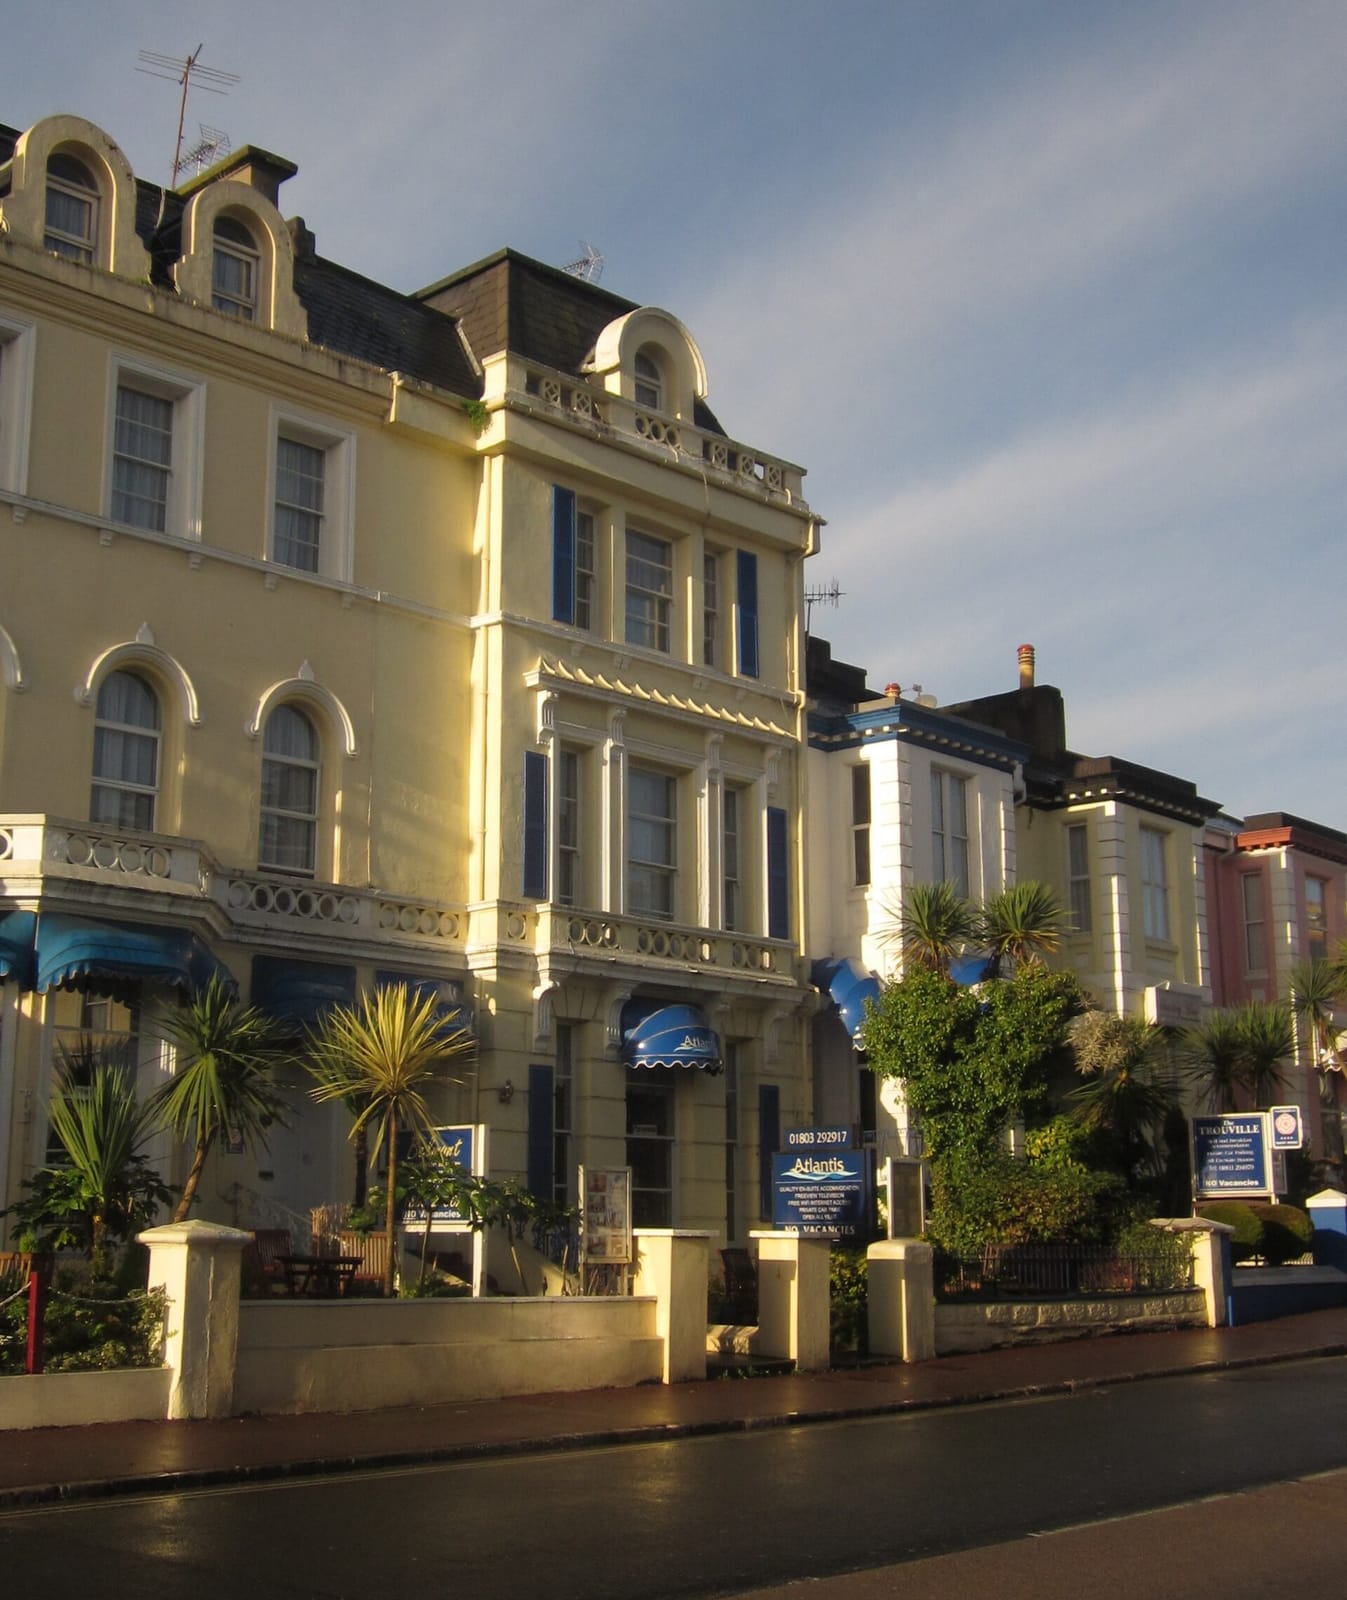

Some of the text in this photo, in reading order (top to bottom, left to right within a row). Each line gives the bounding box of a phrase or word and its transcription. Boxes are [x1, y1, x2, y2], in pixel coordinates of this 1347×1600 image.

[1200, 1124, 1260, 1135] TROUVILLE
[789, 1130, 847, 1145] 01803 292917
[794, 1157, 844, 1173] Atlantis
[419, 1207, 461, 1218] Vancies
[785, 1225, 856, 1235] NO VACANCIES
